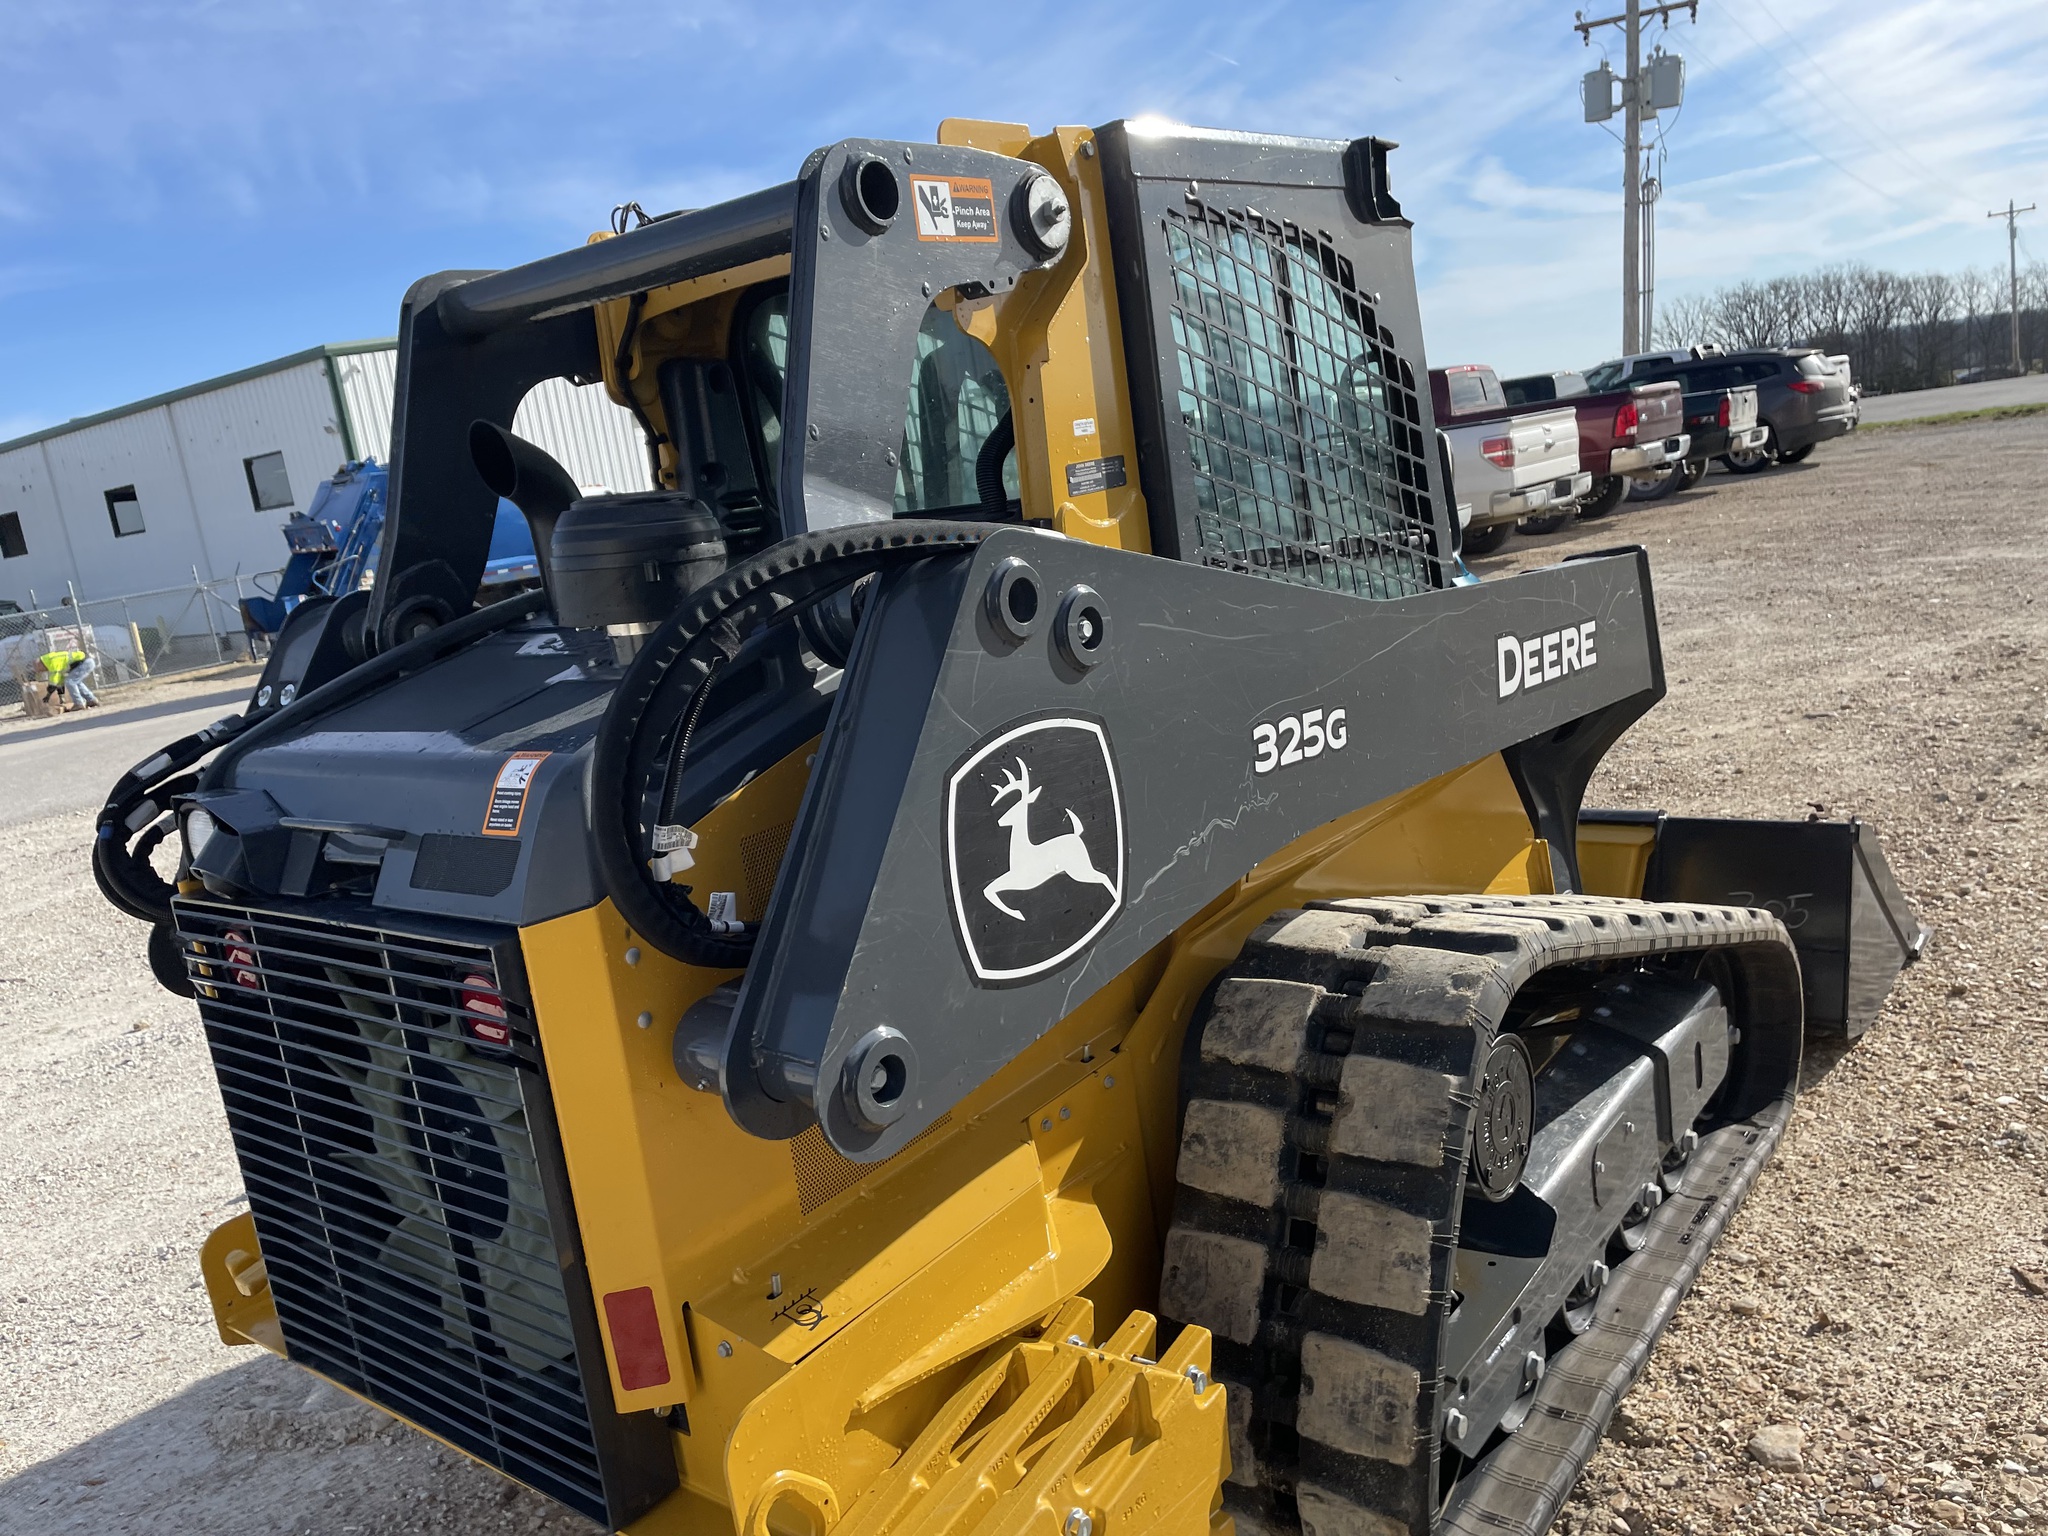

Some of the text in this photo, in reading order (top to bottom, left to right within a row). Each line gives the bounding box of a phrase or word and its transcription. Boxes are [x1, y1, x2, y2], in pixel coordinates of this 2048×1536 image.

[959, 184, 989, 194] WARNING
[954, 206, 990, 216] Pinch Area
[956, 220, 987, 230] Keep Away
[1497, 620, 1597, 698] DEERE
[1252, 708, 1347, 773] 325G
[1050, 1473, 1068, 1496] USA
